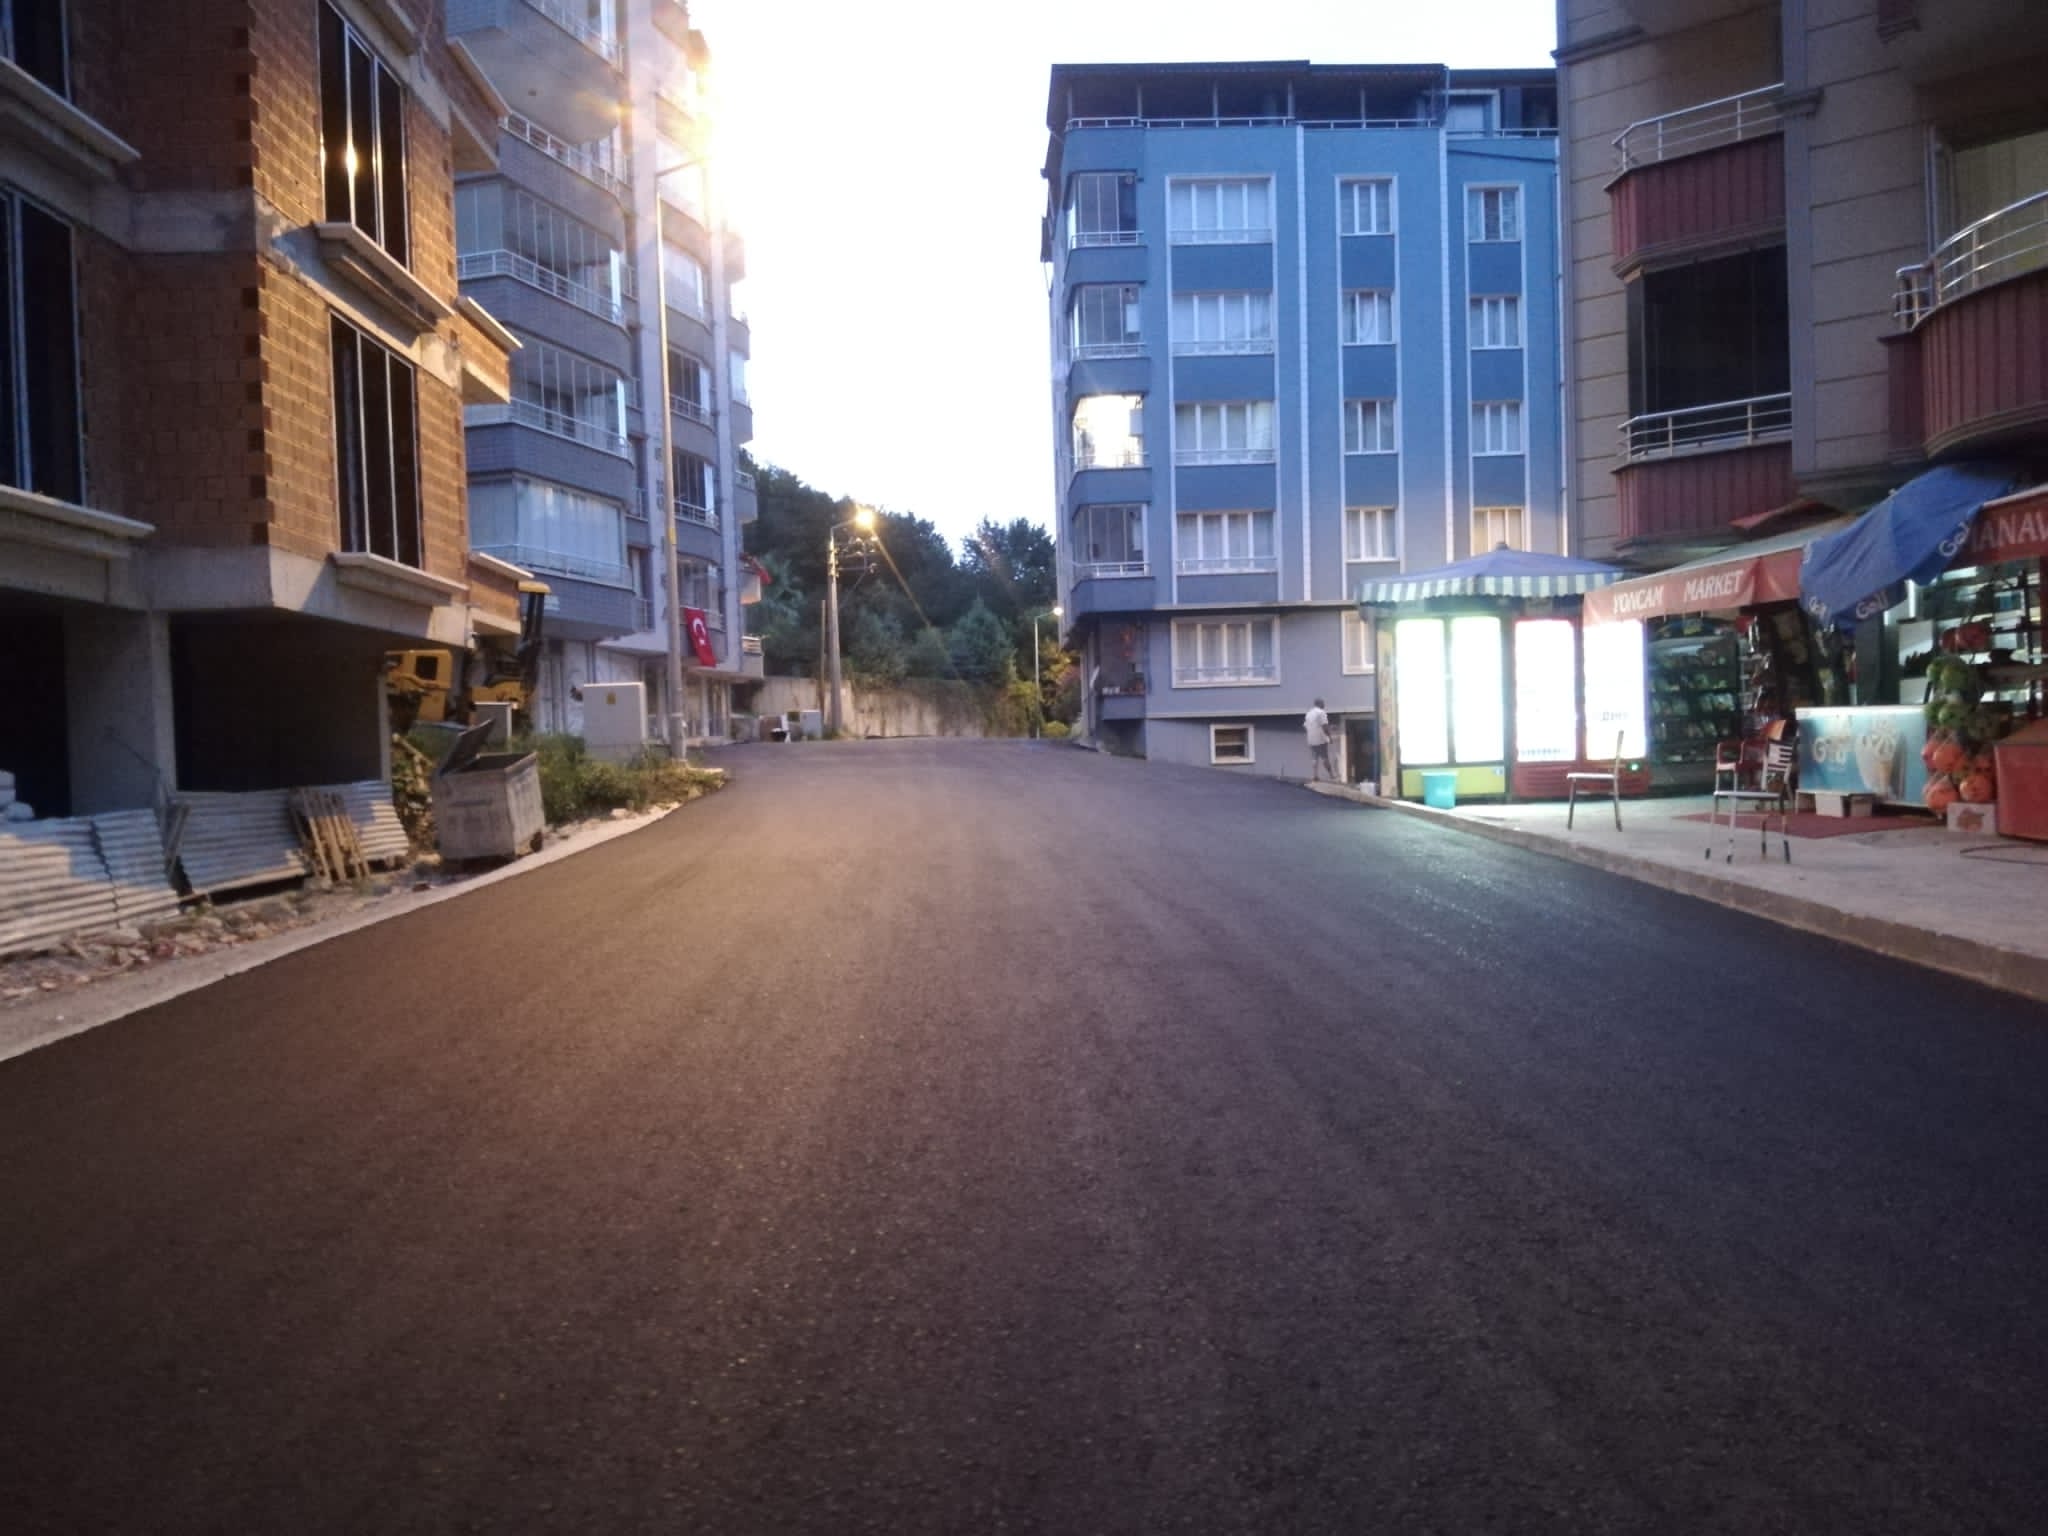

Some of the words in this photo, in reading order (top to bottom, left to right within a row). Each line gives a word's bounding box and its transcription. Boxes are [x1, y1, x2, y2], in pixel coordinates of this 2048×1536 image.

[1971, 511, 2048, 553] ANAV
[1612, 585, 1664, 614] YONCAM
[1683, 569, 1744, 602] MARKET
